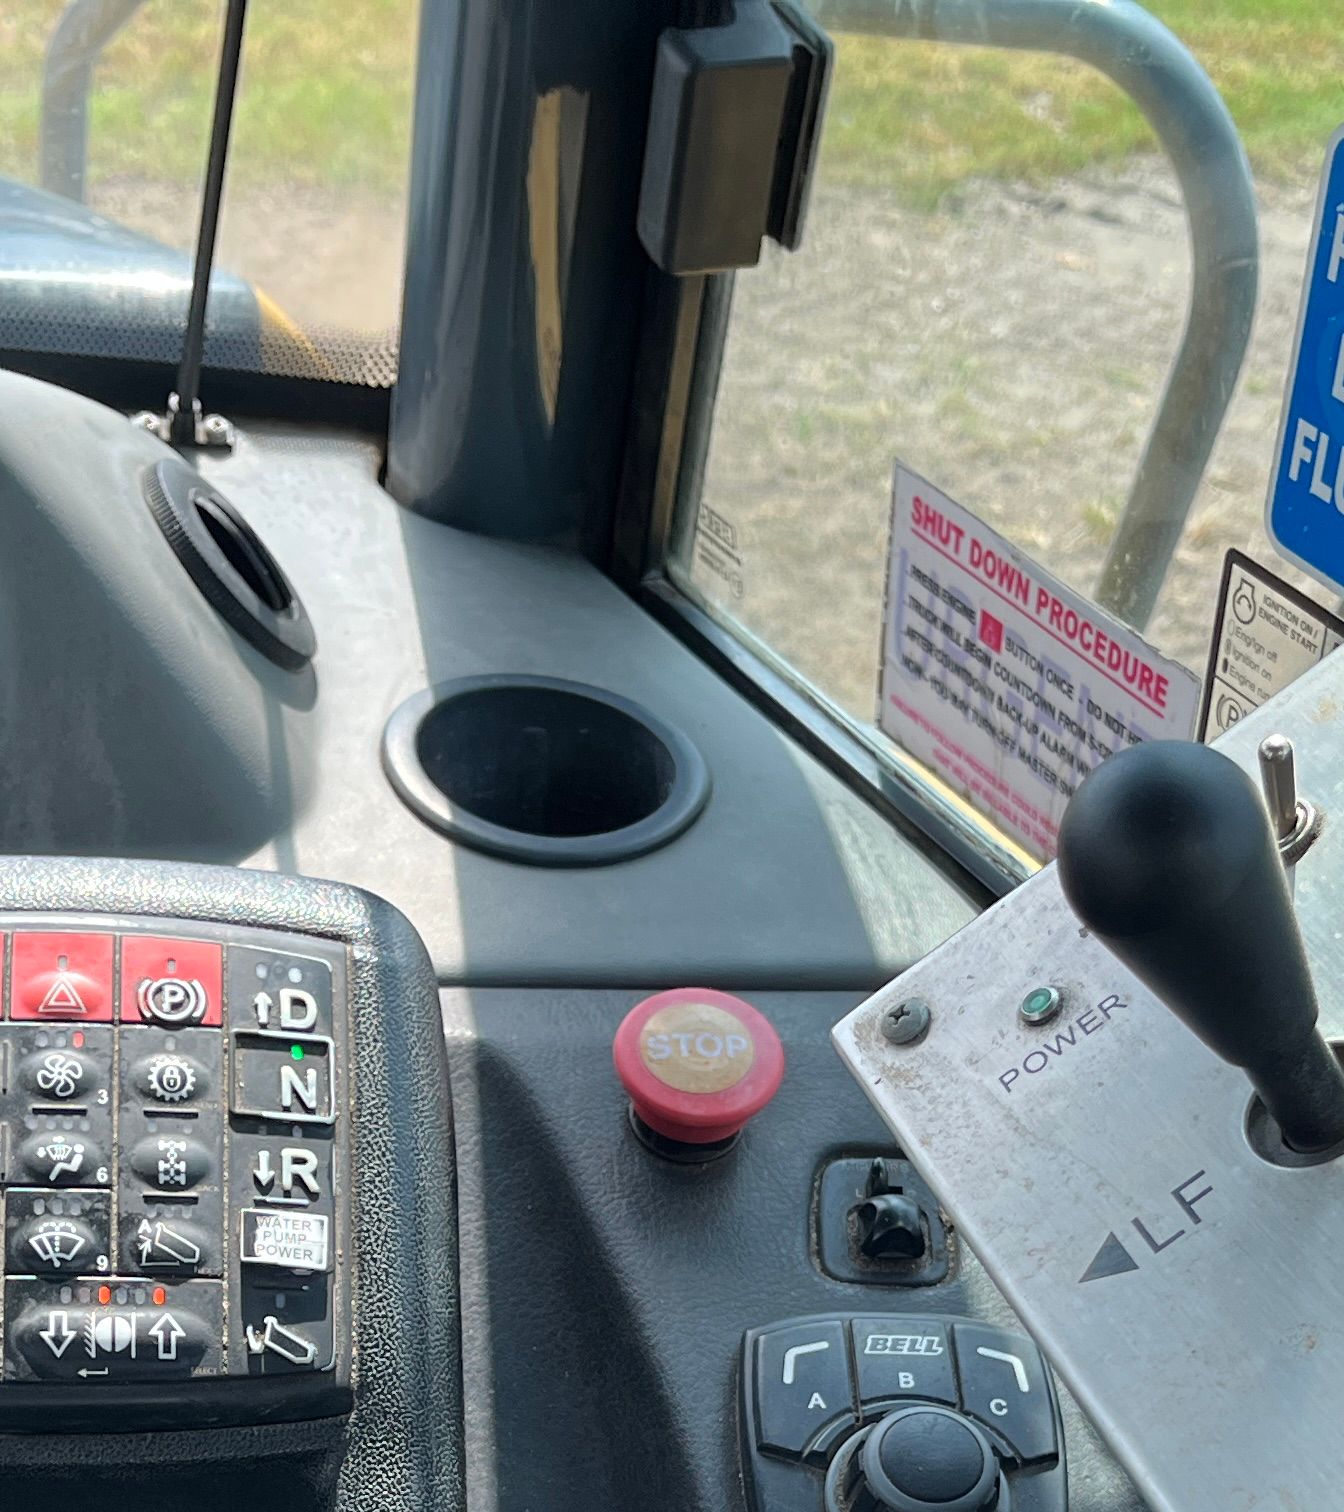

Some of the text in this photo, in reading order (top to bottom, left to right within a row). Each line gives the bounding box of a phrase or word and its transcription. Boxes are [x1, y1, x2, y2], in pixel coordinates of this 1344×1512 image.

[911, 497, 1169, 708] SHUT DOWN PROCEDURE
[1263, 594, 1300, 629] IGNITION
[1300, 620, 1312, 636] ON
[1258, 608, 1318, 654] ENGINE START
[1229, 664, 1256, 692] Engine
[1230, 645, 1273, 682] Ignition on
[992, 659, 1056, 720] COUNTDOWN
[1057, 709, 1086, 744] FROM
[1004, 634, 1044, 678] BUTTON
[1045, 665, 1073, 701] ONCE
[1086, 698, 1102, 722] DO
[1103, 711, 1125, 740] NOT
[1017, 745, 1057, 788] MASTER
[1040, 728, 1075, 768] ALARM
[279, 988, 318, 1029] D
[647, 1032, 748, 1060] STOP
[998, 993, 1128, 1093] POWER
[97, 1088, 109, 1104] 3
[280, 1065, 318, 1111] N
[96, 1167, 109, 1183] 6
[280, 1148, 320, 1194] R
[256, 1216, 312, 1231] WATER
[1132, 1169, 1217, 1255] LF
[256, 1244, 313, 1261] POWER
[263, 1230, 306, 1248] PUMP
[96, 1255, 109, 1271] 9
[864, 1334, 944, 1356] BELL
[898, 1371, 915, 1389] B
[807, 1393, 826, 1410] A
[989, 1397, 1008, 1416] C
